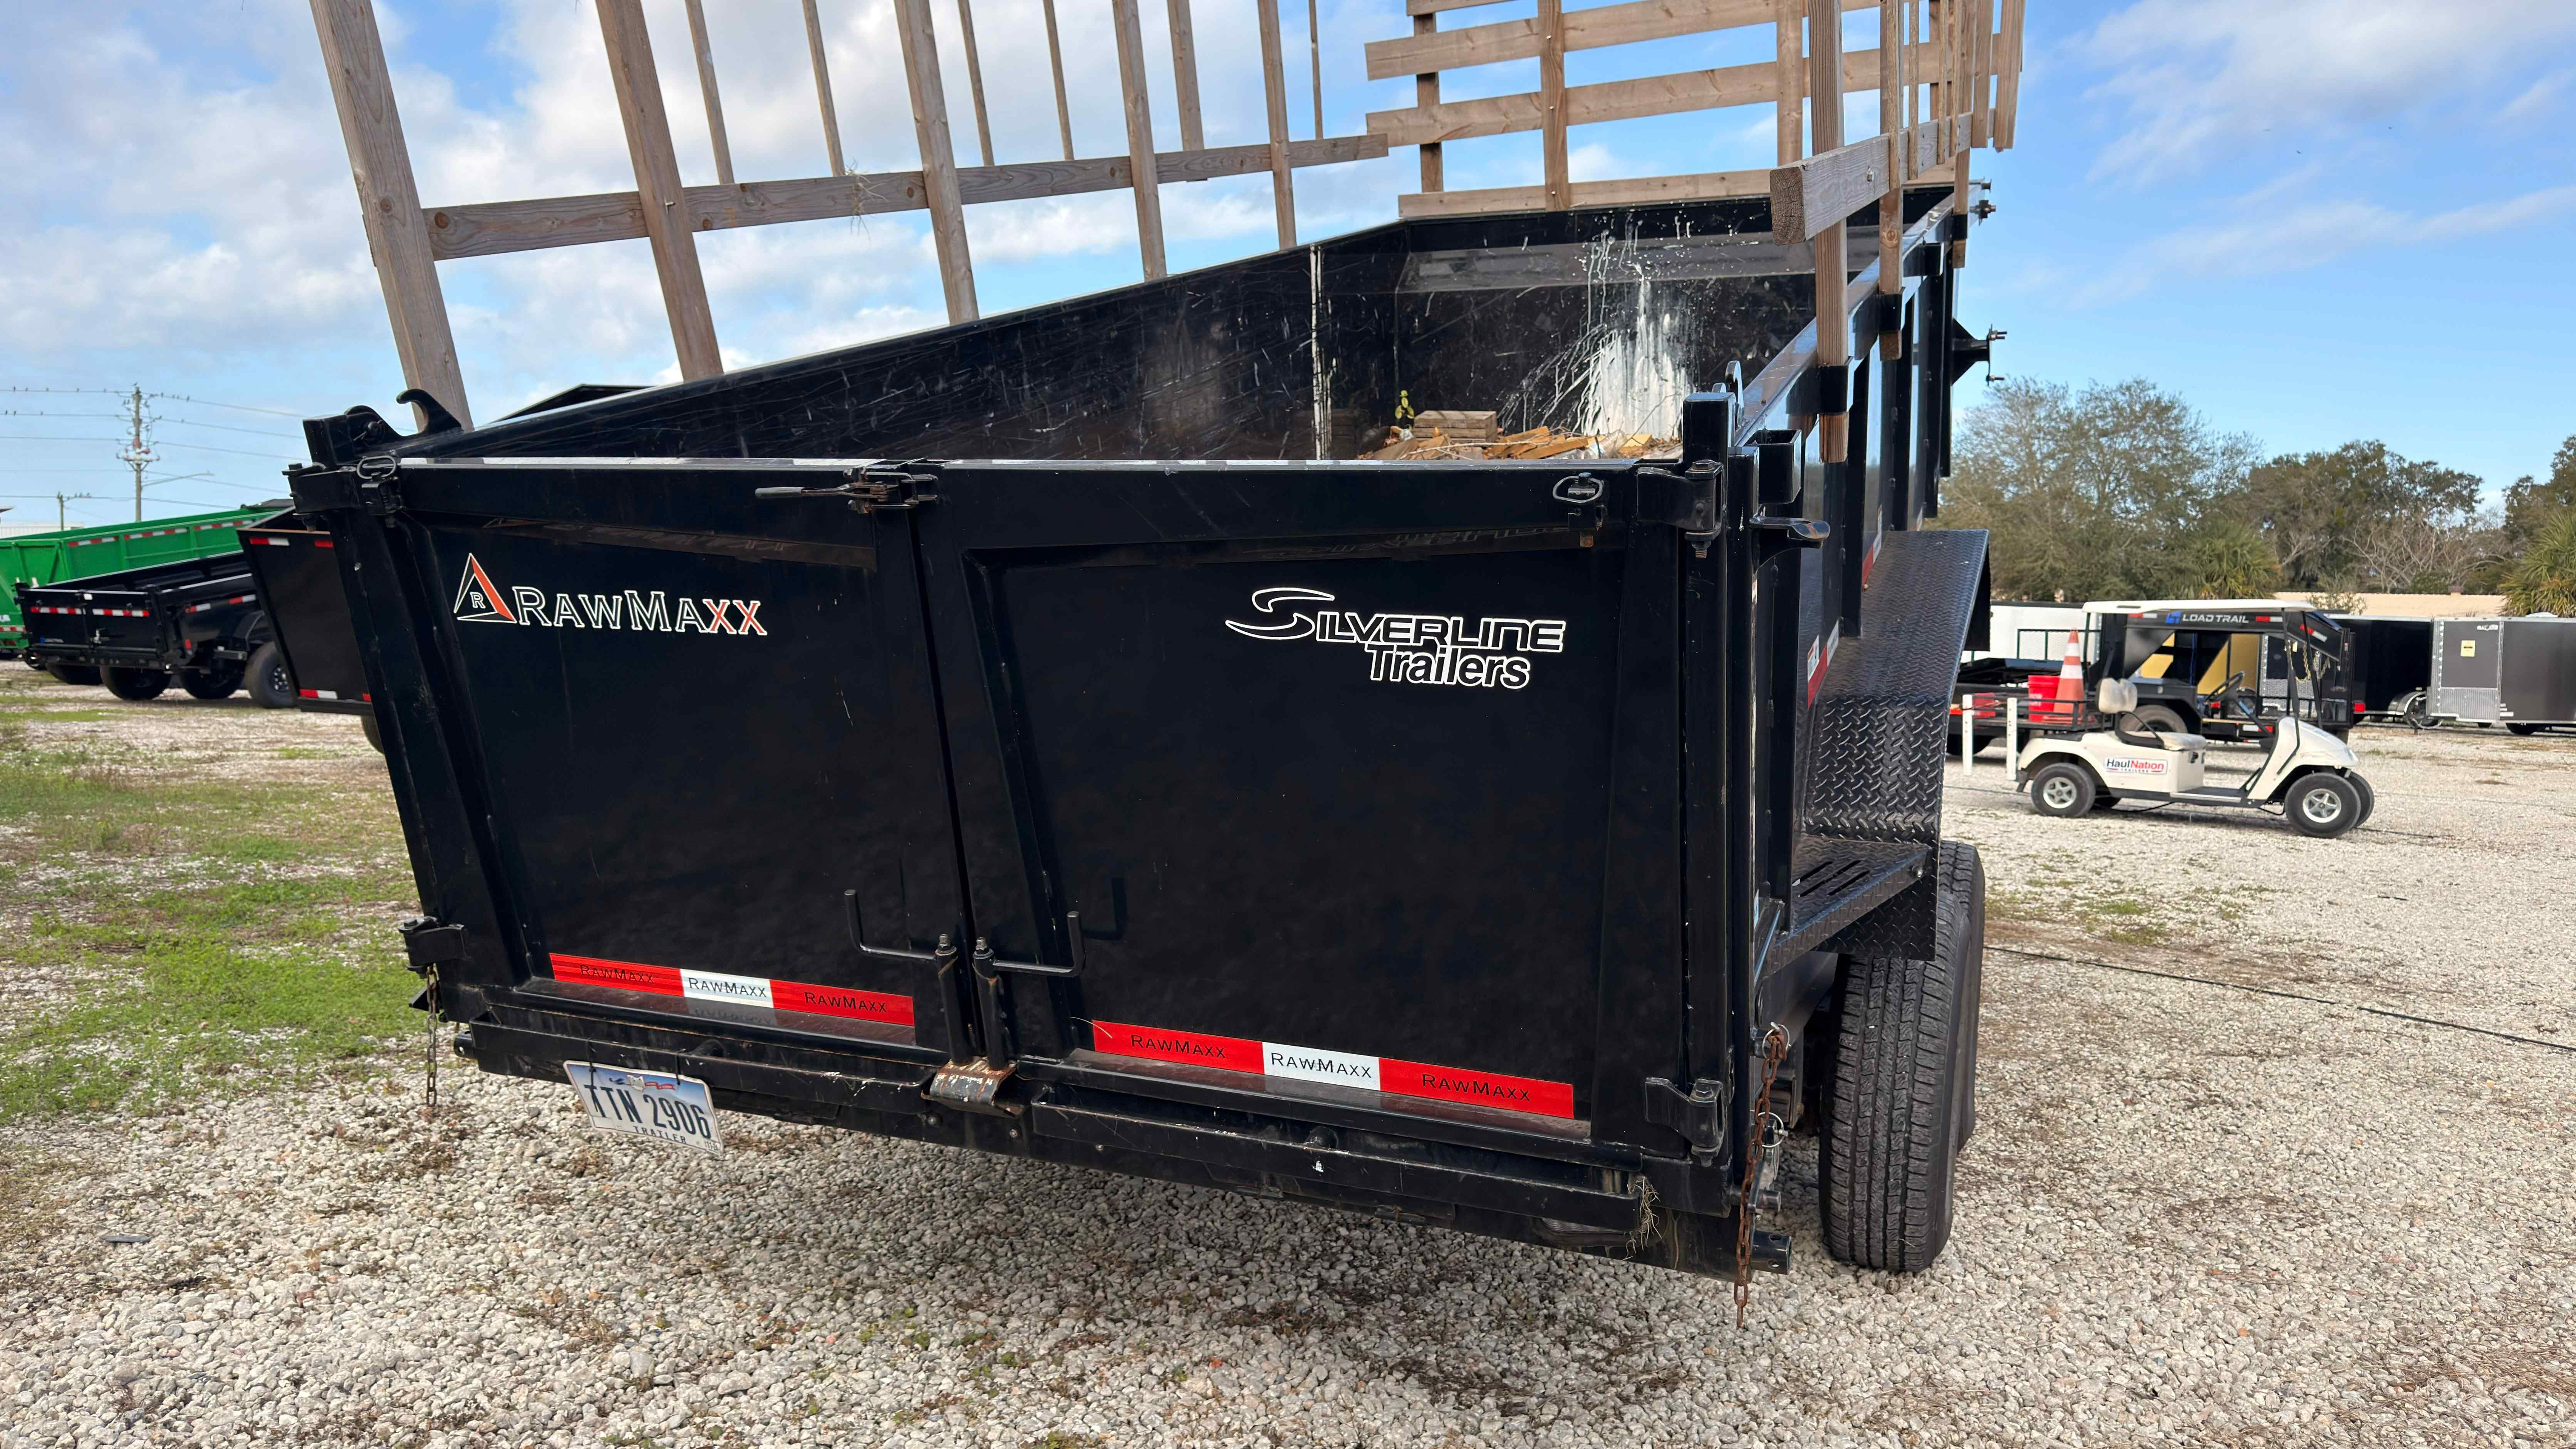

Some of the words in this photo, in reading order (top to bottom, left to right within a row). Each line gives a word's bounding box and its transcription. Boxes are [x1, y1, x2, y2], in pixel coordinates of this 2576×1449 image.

[2216, 615, 2249, 624] TRAIL
[1364, 642, 1531, 689] Trailers
[643, 1094, 711, 1139] 2906
[633, 1125, 687, 1144] TRAILER
